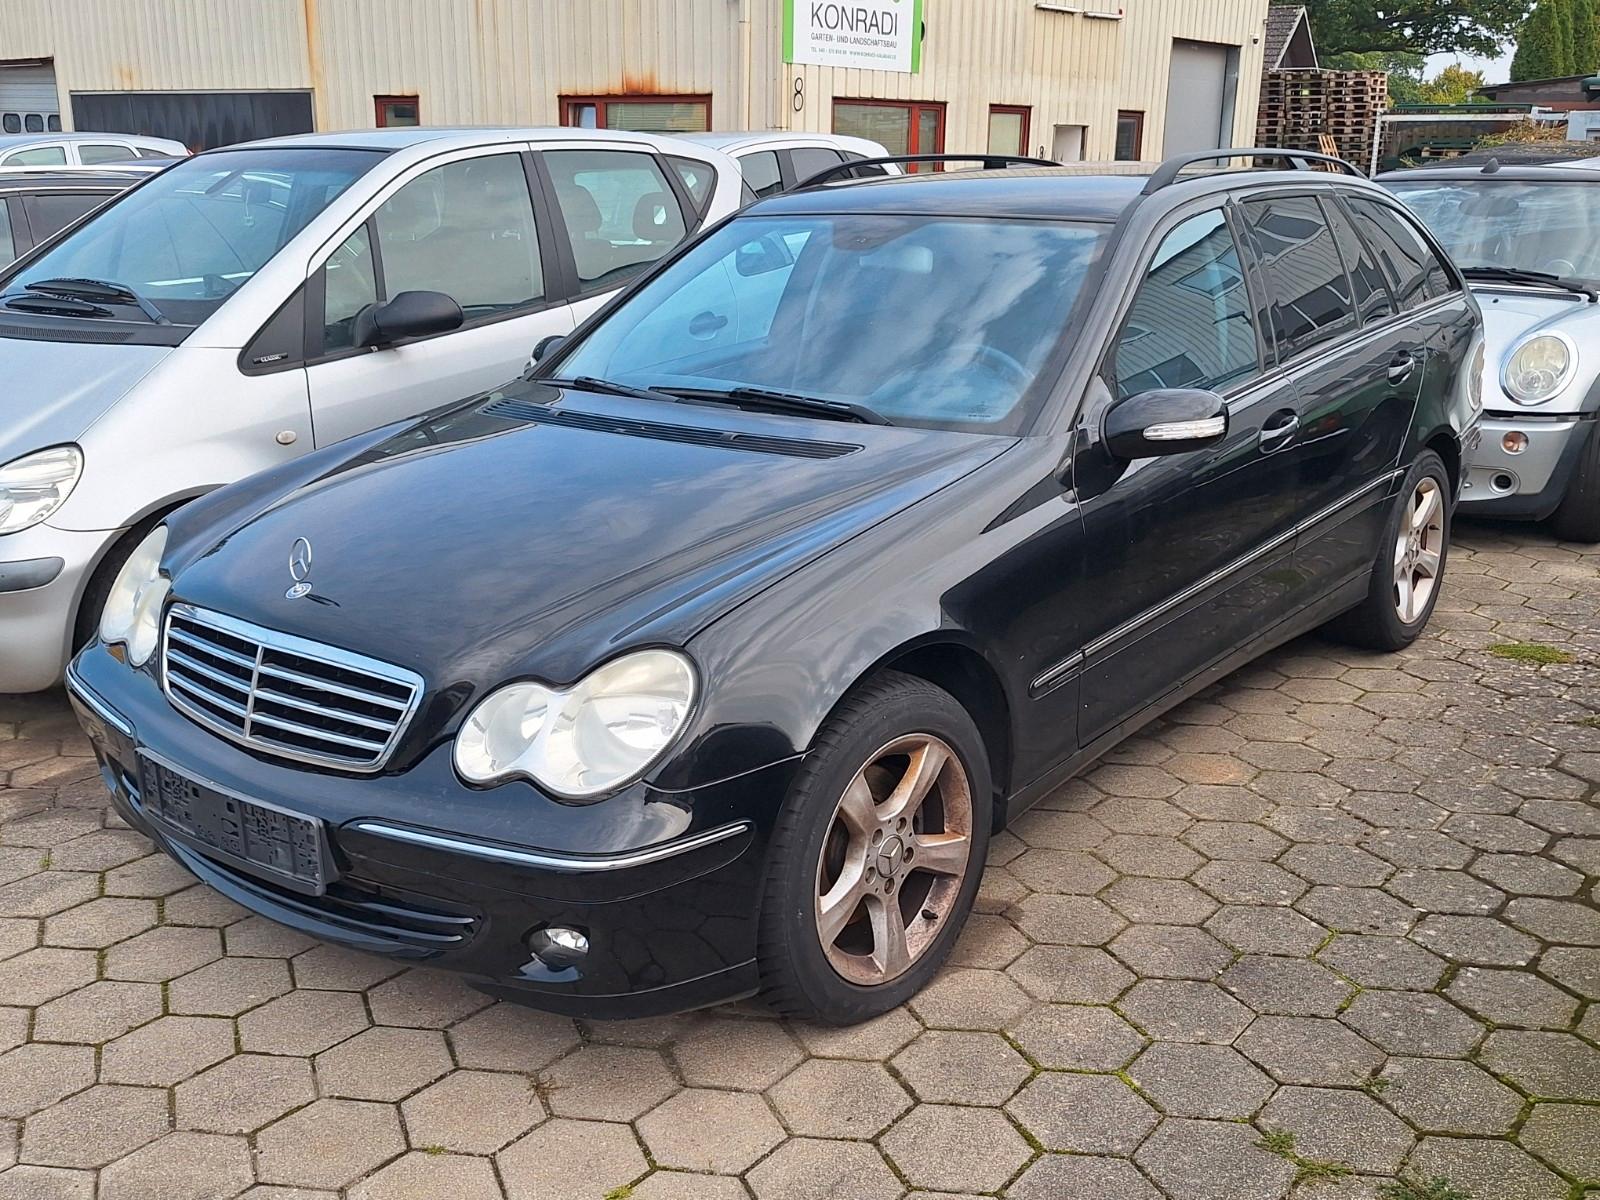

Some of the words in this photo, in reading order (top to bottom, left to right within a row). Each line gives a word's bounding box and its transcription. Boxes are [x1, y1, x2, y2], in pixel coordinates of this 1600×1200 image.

[810, 1, 898, 36] KONRADI
[810, 32, 835, 42] GARTEN-
[836, 35, 849, 44] UND
[849, 38, 898, 49] LANDSCHAFTSBAU
[793, 77, 804, 112] 8
